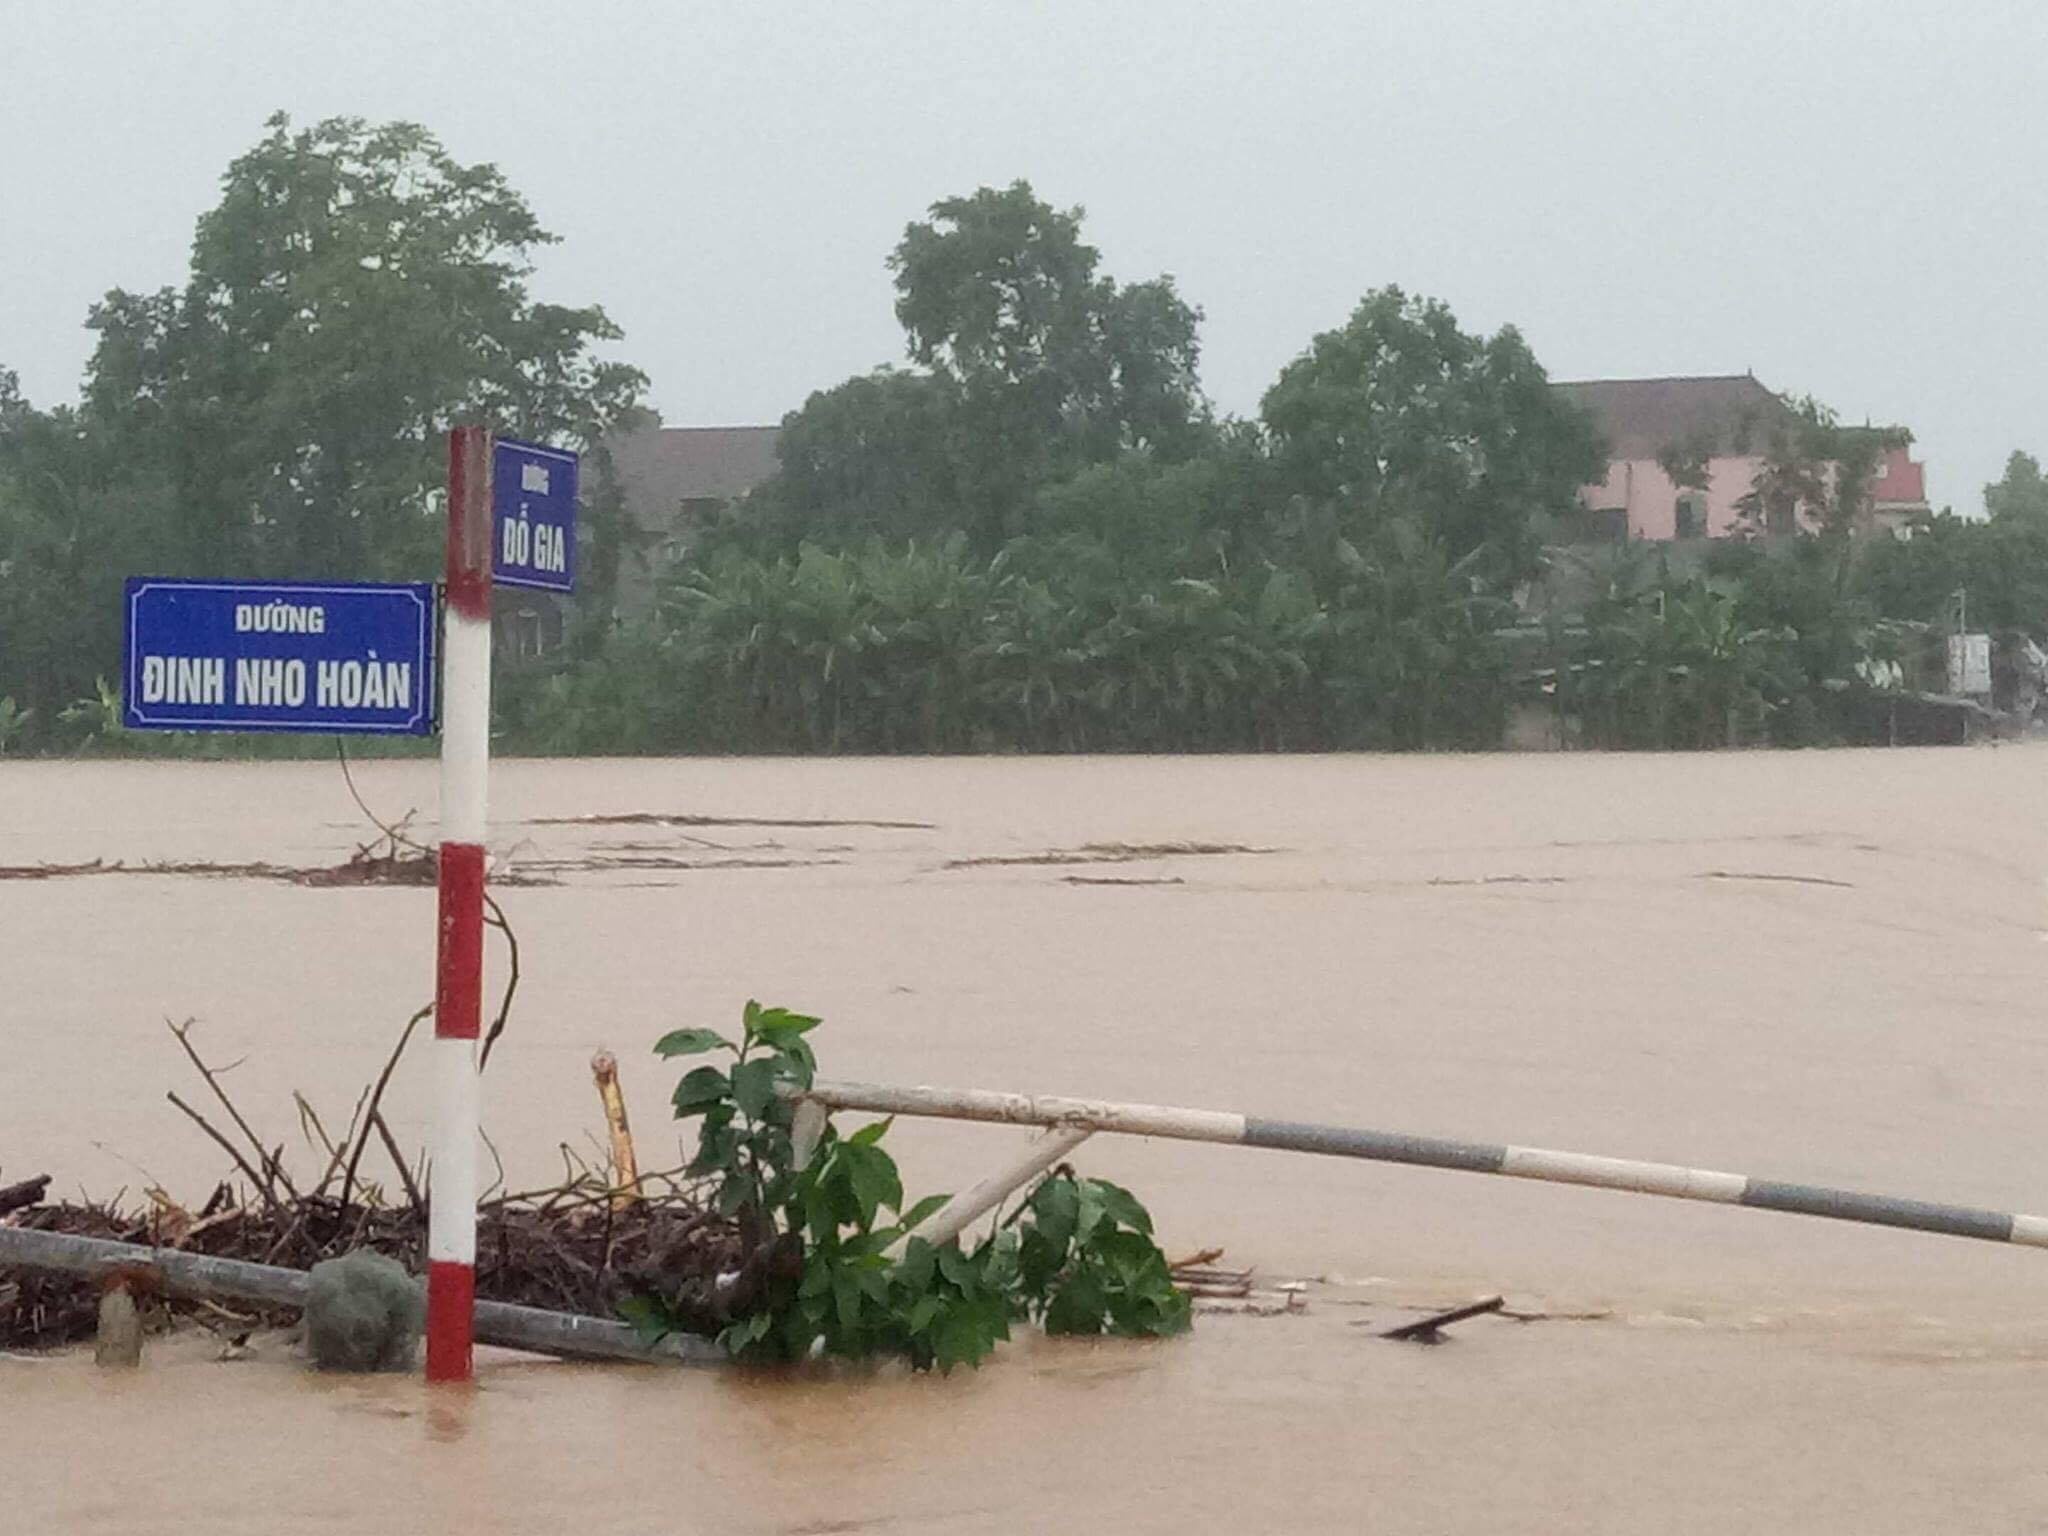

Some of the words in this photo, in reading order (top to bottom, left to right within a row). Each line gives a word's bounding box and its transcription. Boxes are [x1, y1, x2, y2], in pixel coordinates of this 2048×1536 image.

[534, 523, 565, 573] GIA
[235, 598, 325, 633] ĐƯỜNG
[142, 655, 225, 704] ĐINH
[235, 658, 306, 707] NHO
[317, 650, 410, 709] HOÀN
